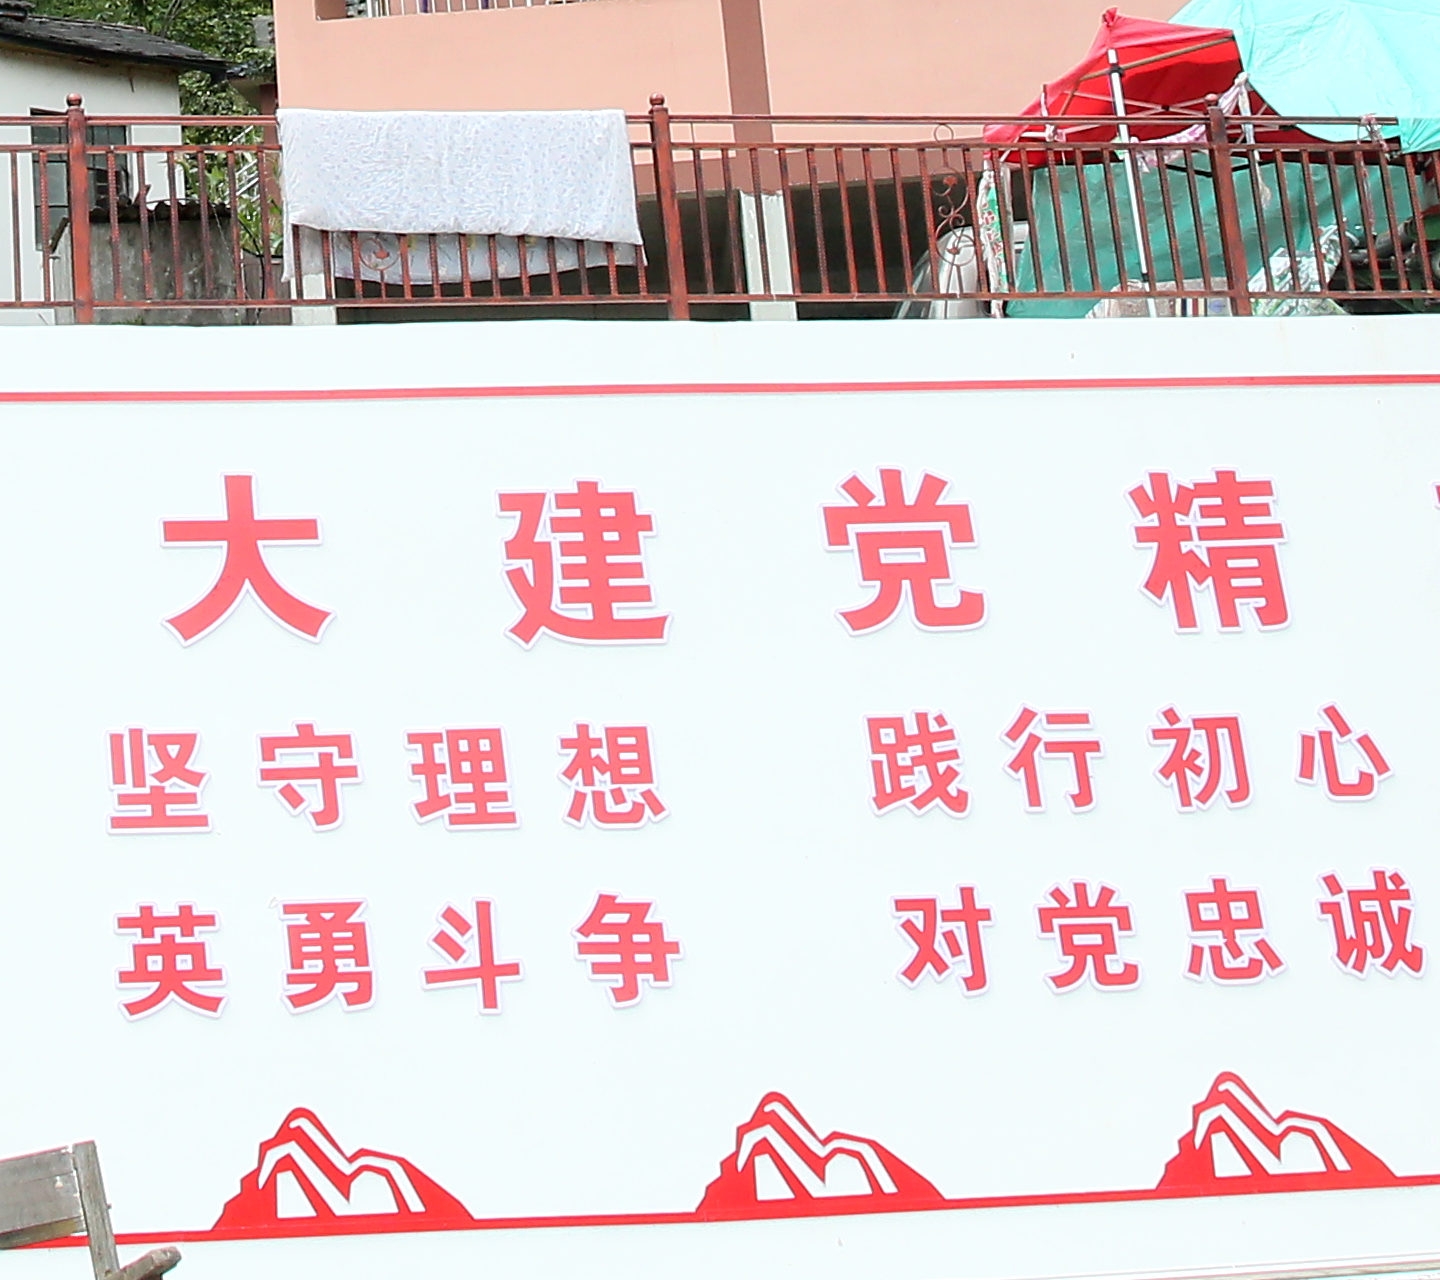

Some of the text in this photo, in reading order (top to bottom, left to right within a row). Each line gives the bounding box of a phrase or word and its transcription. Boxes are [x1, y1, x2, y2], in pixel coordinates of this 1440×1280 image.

[109, 722, 668, 831] 坚守理想
[866, 703, 1392, 815] 践行初心
[116, 893, 682, 1016] 英勇斗争
[893, 869, 1425, 992] 对党忠诚
